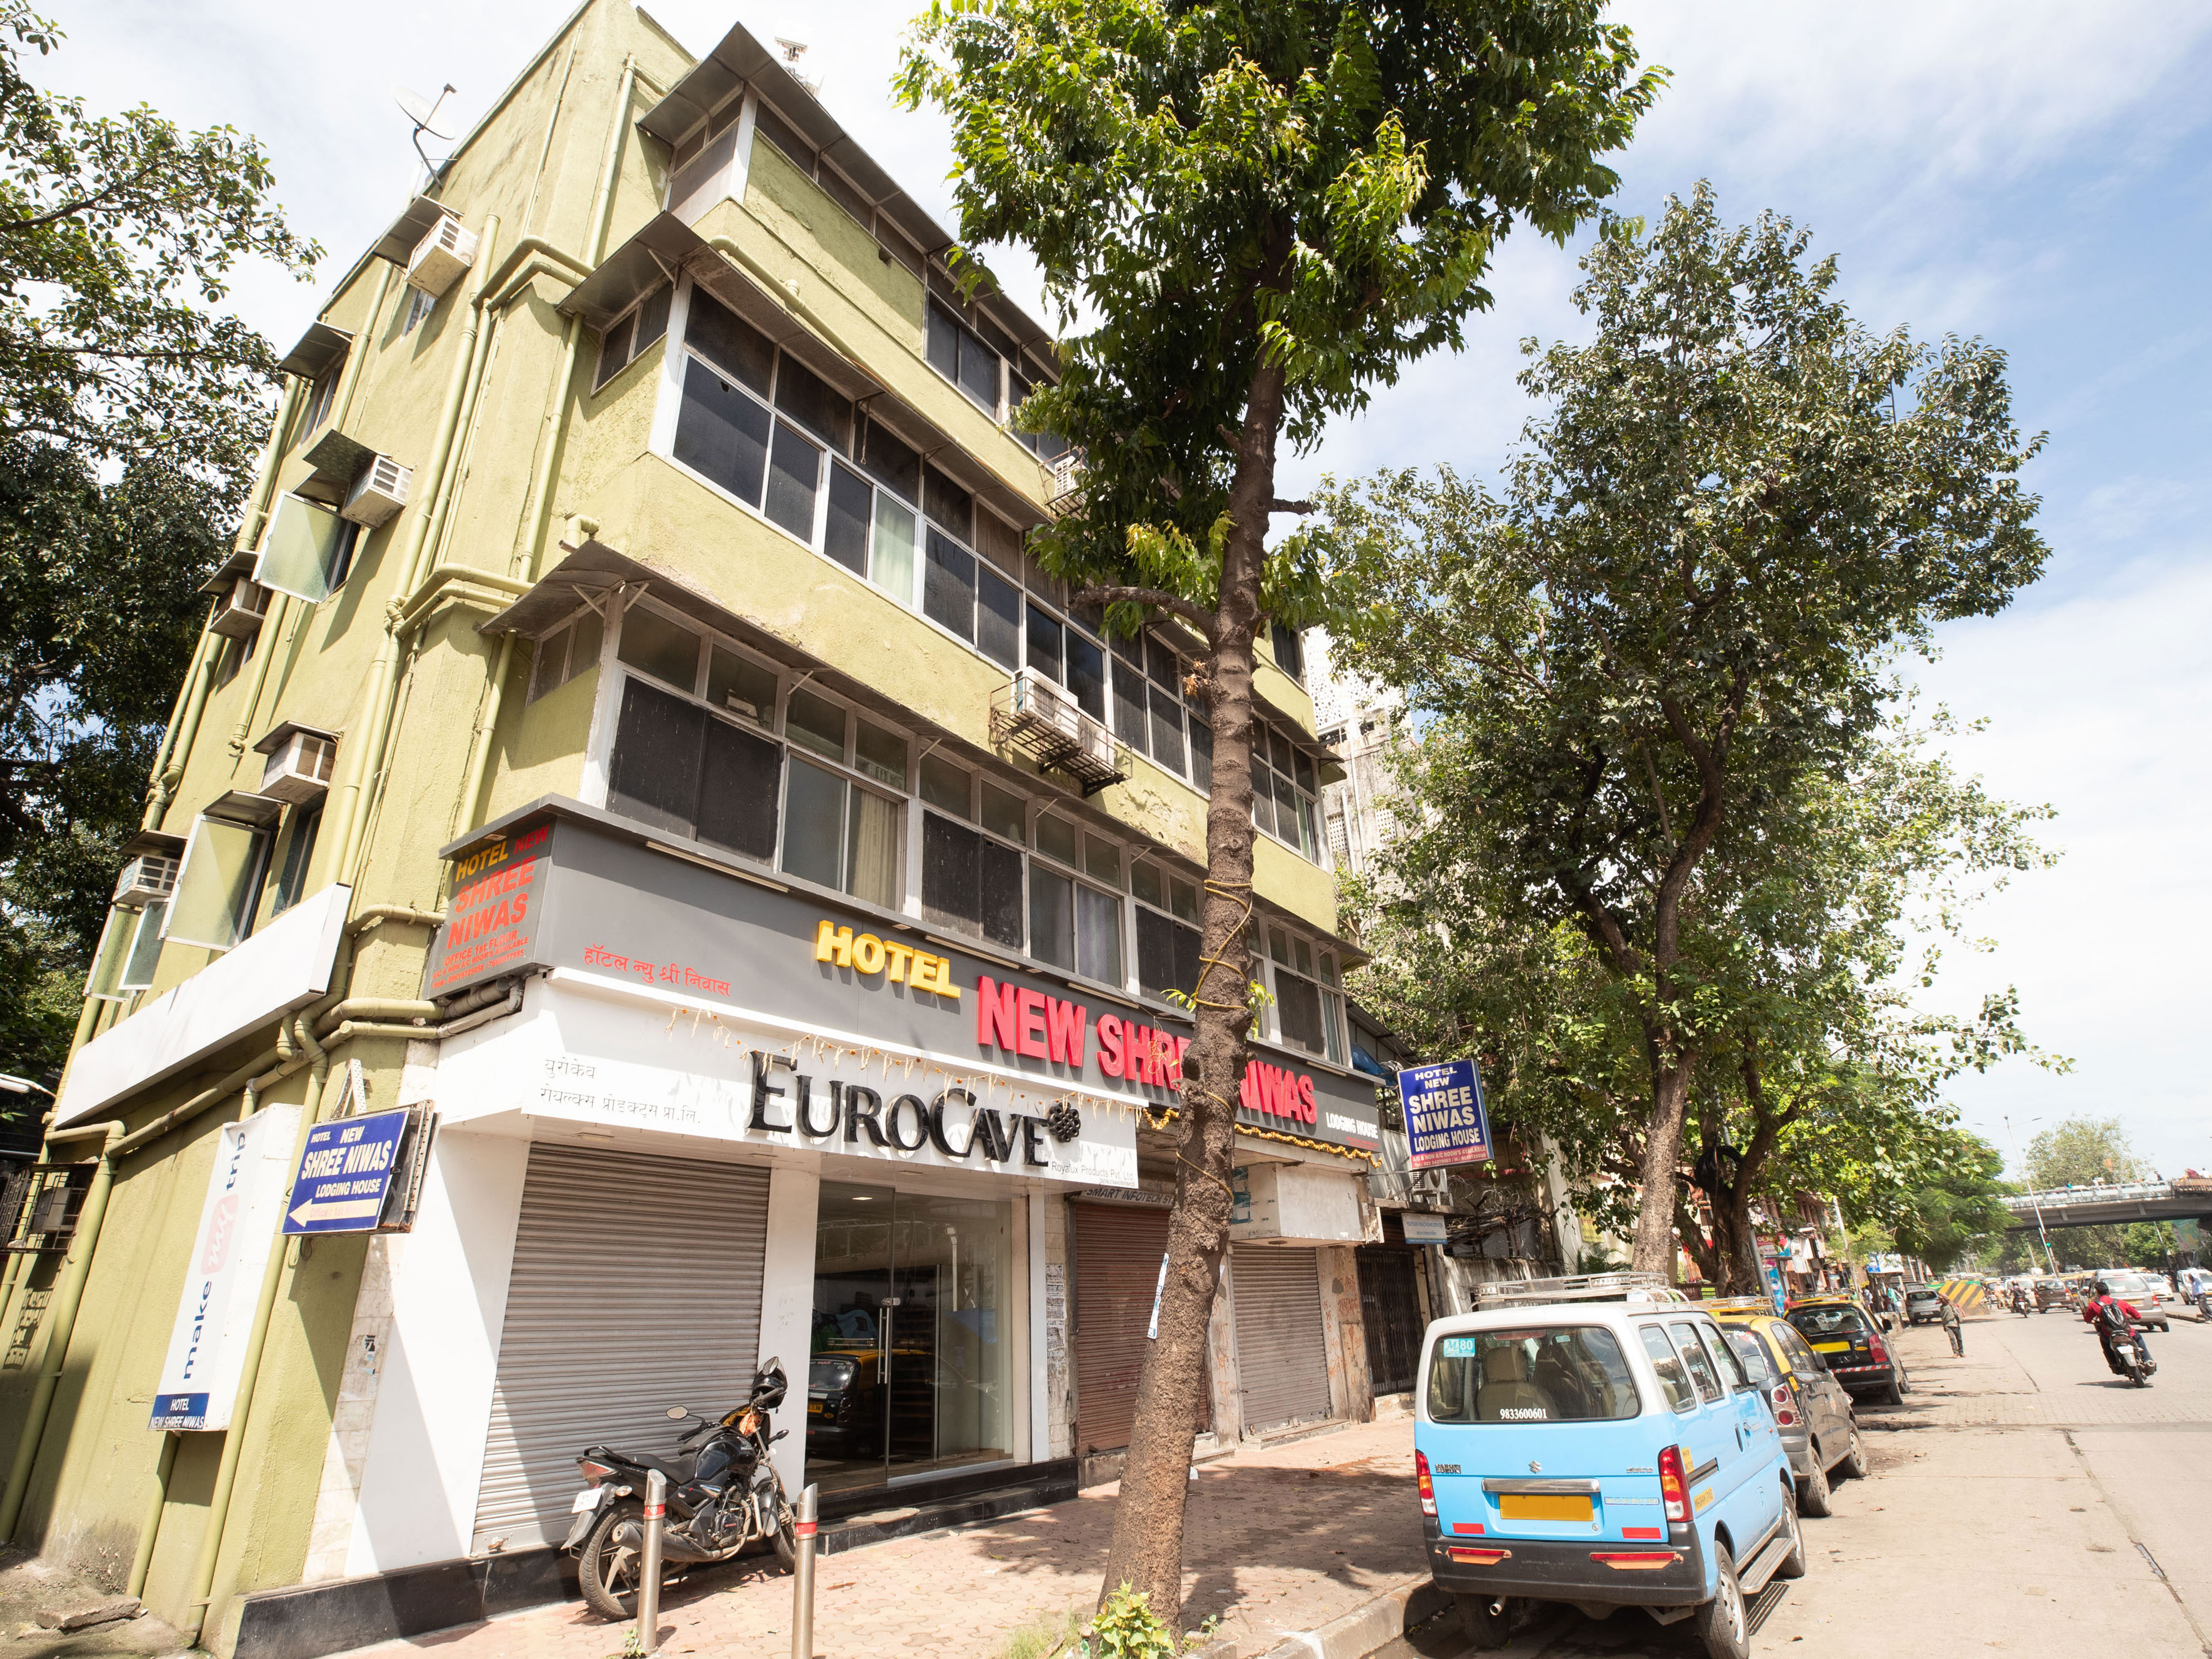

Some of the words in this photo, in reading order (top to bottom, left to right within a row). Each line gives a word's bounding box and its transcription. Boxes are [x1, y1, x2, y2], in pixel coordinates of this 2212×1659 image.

[456, 841, 508, 882] HOTEL
[514, 825, 550, 854] NEW
[455, 854, 536, 914] SHREE
[447, 893, 528, 950] NIWAS
[444, 947, 472, 967] OFFICE
[475, 942, 487, 955] 1st
[488, 929, 518, 950] FLOOR
[816, 920, 961, 998] HOTEL
[659, 963, 681, 984] श्री
[685, 967, 731, 997] निवास
[978, 975, 1087, 1067] NEW
[1097, 1014, 1192, 1092] SHR
[1415, 1067, 1457, 1081] HOTEL
[1425, 1077, 1449, 1089] NEW
[1408, 1086, 1473, 1114] SHREE
[1326, 1112, 1357, 1134] LODGING
[1356, 1119, 1379, 1139] HOUSE
[1412, 1106, 1475, 1134] NIWAS
[311, 1131, 331, 1143] HOTEL
[340, 1126, 365, 1144] NEW
[1414, 1132, 1451, 1152] LODGING
[1451, 1128, 1480, 1146] HOUSE
[301, 1147, 347, 1180] SHREE
[342, 1140, 392, 1174] NIWAS
[1462, 1146, 1486, 1155] AVAILABLE
[1052, 1161, 1078, 1175] Royalux
[1081, 1165, 1109, 1177] Products
[315, 1181, 351, 1198] LODGING
[351, 1178, 382, 1194] HOUSE
[1121, 1190, 1161, 1203] INFOTECH
[184, 1281, 211, 1379] make
[226, 1133, 246, 1191] trip
[1460, 1340, 1473, 1350] 80
[170, 1398, 190, 1411] HOTEL
[1500, 1408, 1547, 1420] 9833600601
[149, 1416, 165, 1428] NEW
[164, 1416, 184, 1428] SHREE
[182, 1416, 205, 1428] NIWAS
